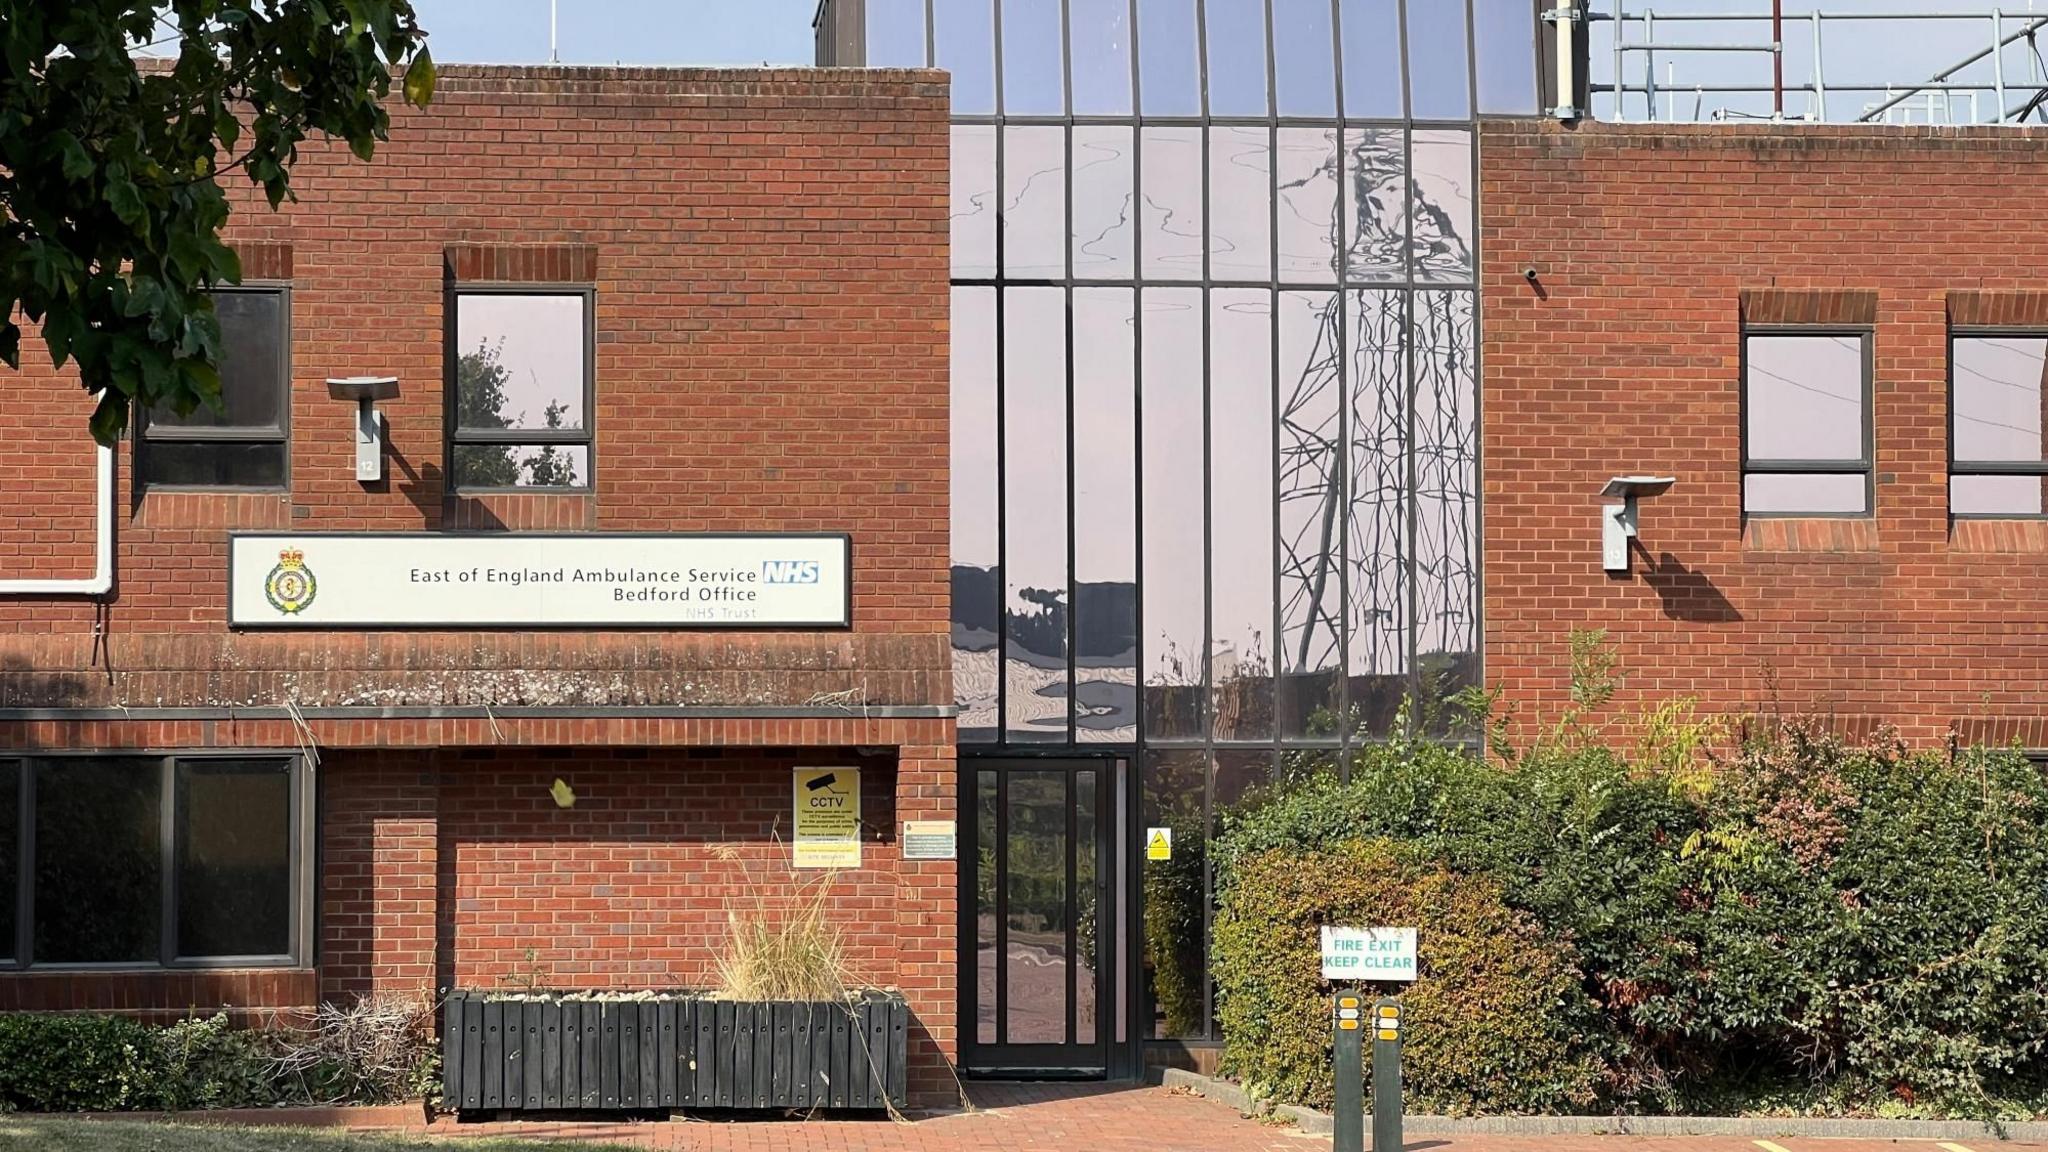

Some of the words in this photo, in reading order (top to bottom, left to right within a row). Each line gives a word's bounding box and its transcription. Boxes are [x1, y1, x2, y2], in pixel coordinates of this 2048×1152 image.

[361, 461, 374, 471] 12
[410, 568, 451, 583] East
[459, 567, 479, 583] of
[487, 567, 564, 586] England
[572, 567, 680, 583] Ambulance
[688, 567, 757, 583] Service
[763, 561, 819, 583] NHS
[614, 586, 691, 601] Bedford
[698, 586, 757, 601] Office
[685, 607, 715, 619] NHS
[722, 607, 757, 619] Trust
[810, 797, 844, 808] CCTV
[1334, 939, 1363, 951] FIRE
[1369, 940, 1402, 952] EXIT
[1325, 956, 1360, 968] KEEP
[1365, 956, 1412, 969] CLEAR
